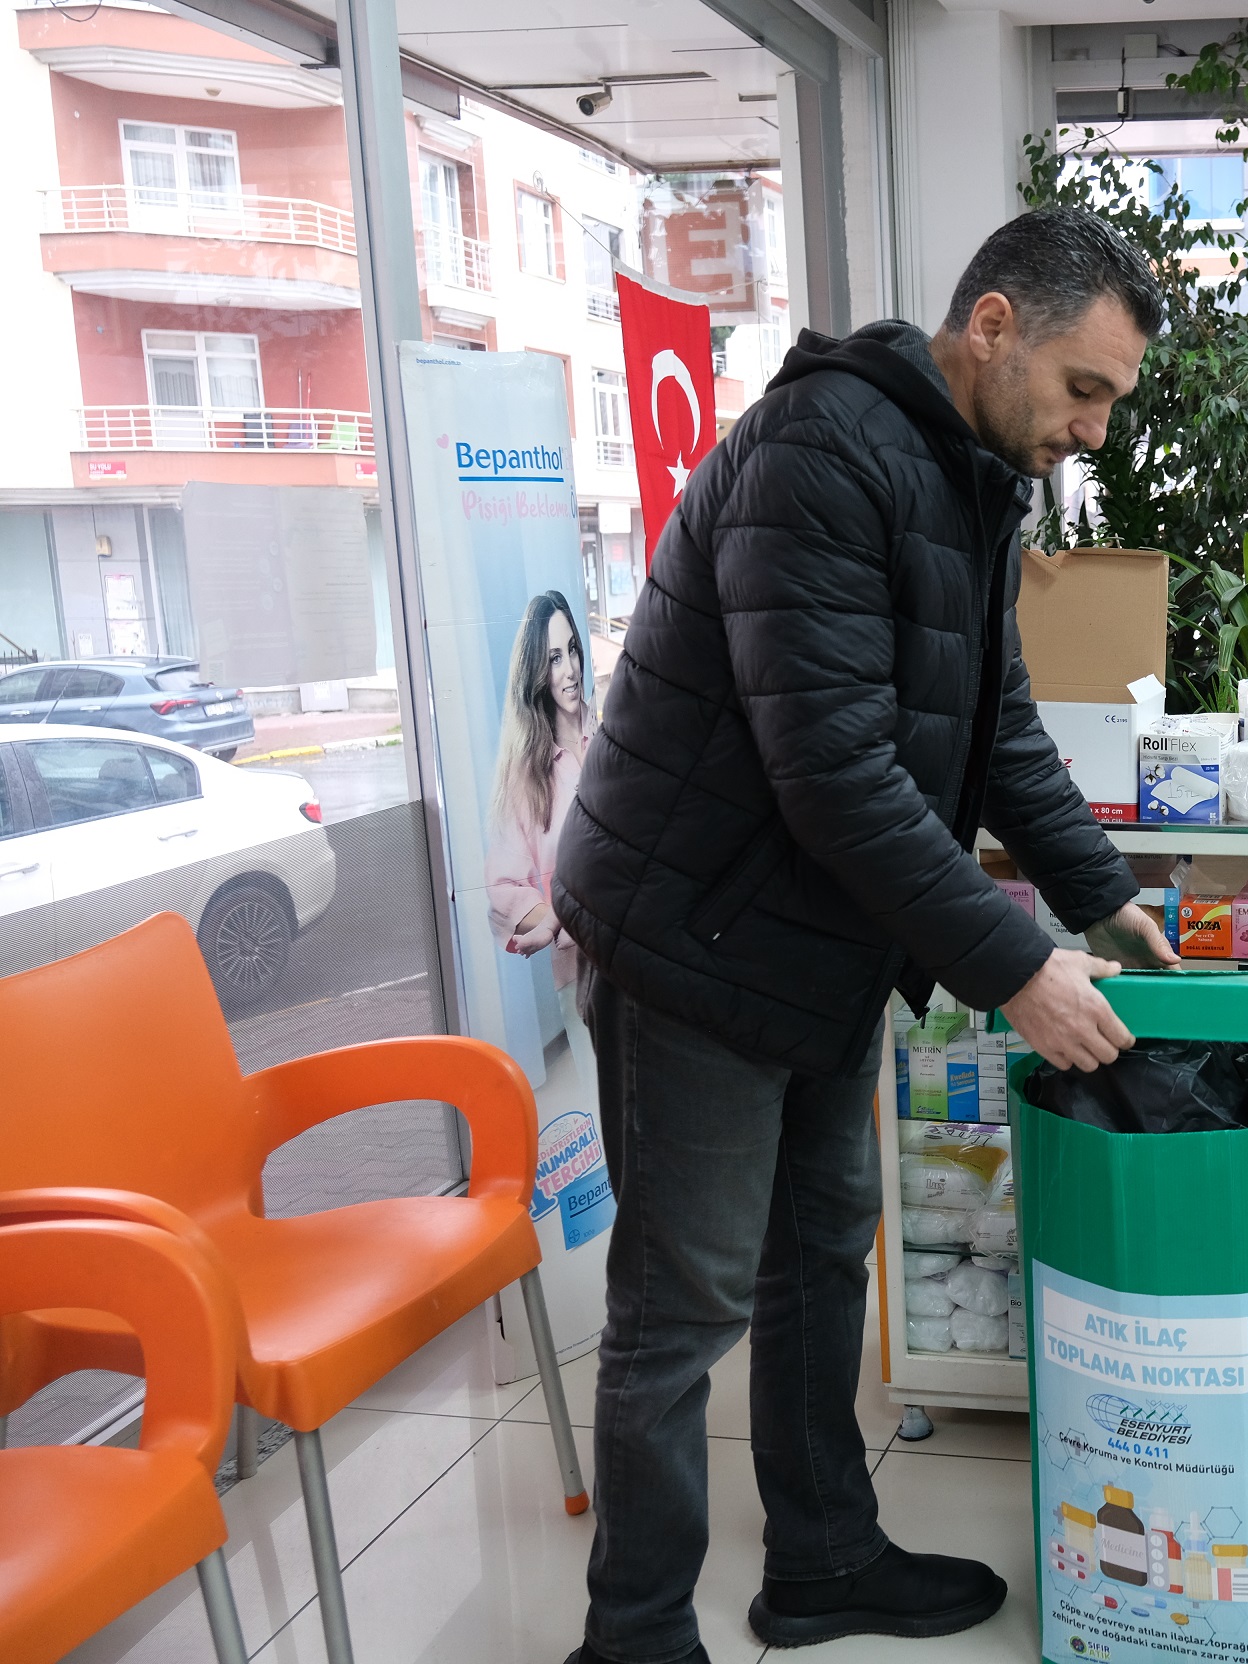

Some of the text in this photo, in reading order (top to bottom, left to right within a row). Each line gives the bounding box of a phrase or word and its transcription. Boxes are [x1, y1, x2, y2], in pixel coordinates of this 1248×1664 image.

[456, 442, 563, 475] Bepanthol
[462, 490, 512, 526] Pişiği
[1101, 807, 1110, 815] 80
[1188, 920, 1221, 930] KOZA
[913, 1045, 942, 1054] METRİN
[539, 1140, 600, 1197] TERCİHİ
[568, 1176, 611, 1211] Bepant
[1084, 1313, 1188, 1352] ATIK İLAÇ
[1048, 1335, 1244, 1387] TOPLAMA NOKTASI
[1117, 1427, 1192, 1445] BELEDİYESİ
[1120, 1418, 1191, 1436] ESENYURT
[1059, 1432, 1234, 1475] Çevre Koruma ve Kontrol Müdürlüğü
[1108, 1437, 1169, 1459] 444 0 411
[1100, 1538, 1145, 1560] Medicine
[1052, 1610, 1086, 1631] zehirler
[1088, 1626, 1099, 1635] ve
[1102, 1626, 1148, 1648] doğadaki
[1151, 1640, 1198, 1656] canlılara
[1200, 1649, 1231, 1660] zarar
[1060, 1600, 1081, 1617] Çöpe
[1083, 1611, 1095, 1620] ve
[1096, 1615, 1135, 1633] çevreye
[1138, 1626, 1168, 1639] atılan
[1209, 1638, 1248, 1653] toprağı
[1087, 1641, 1110, 1653] SIFIR
[1089, 1649, 1111, 1661] ATIK
